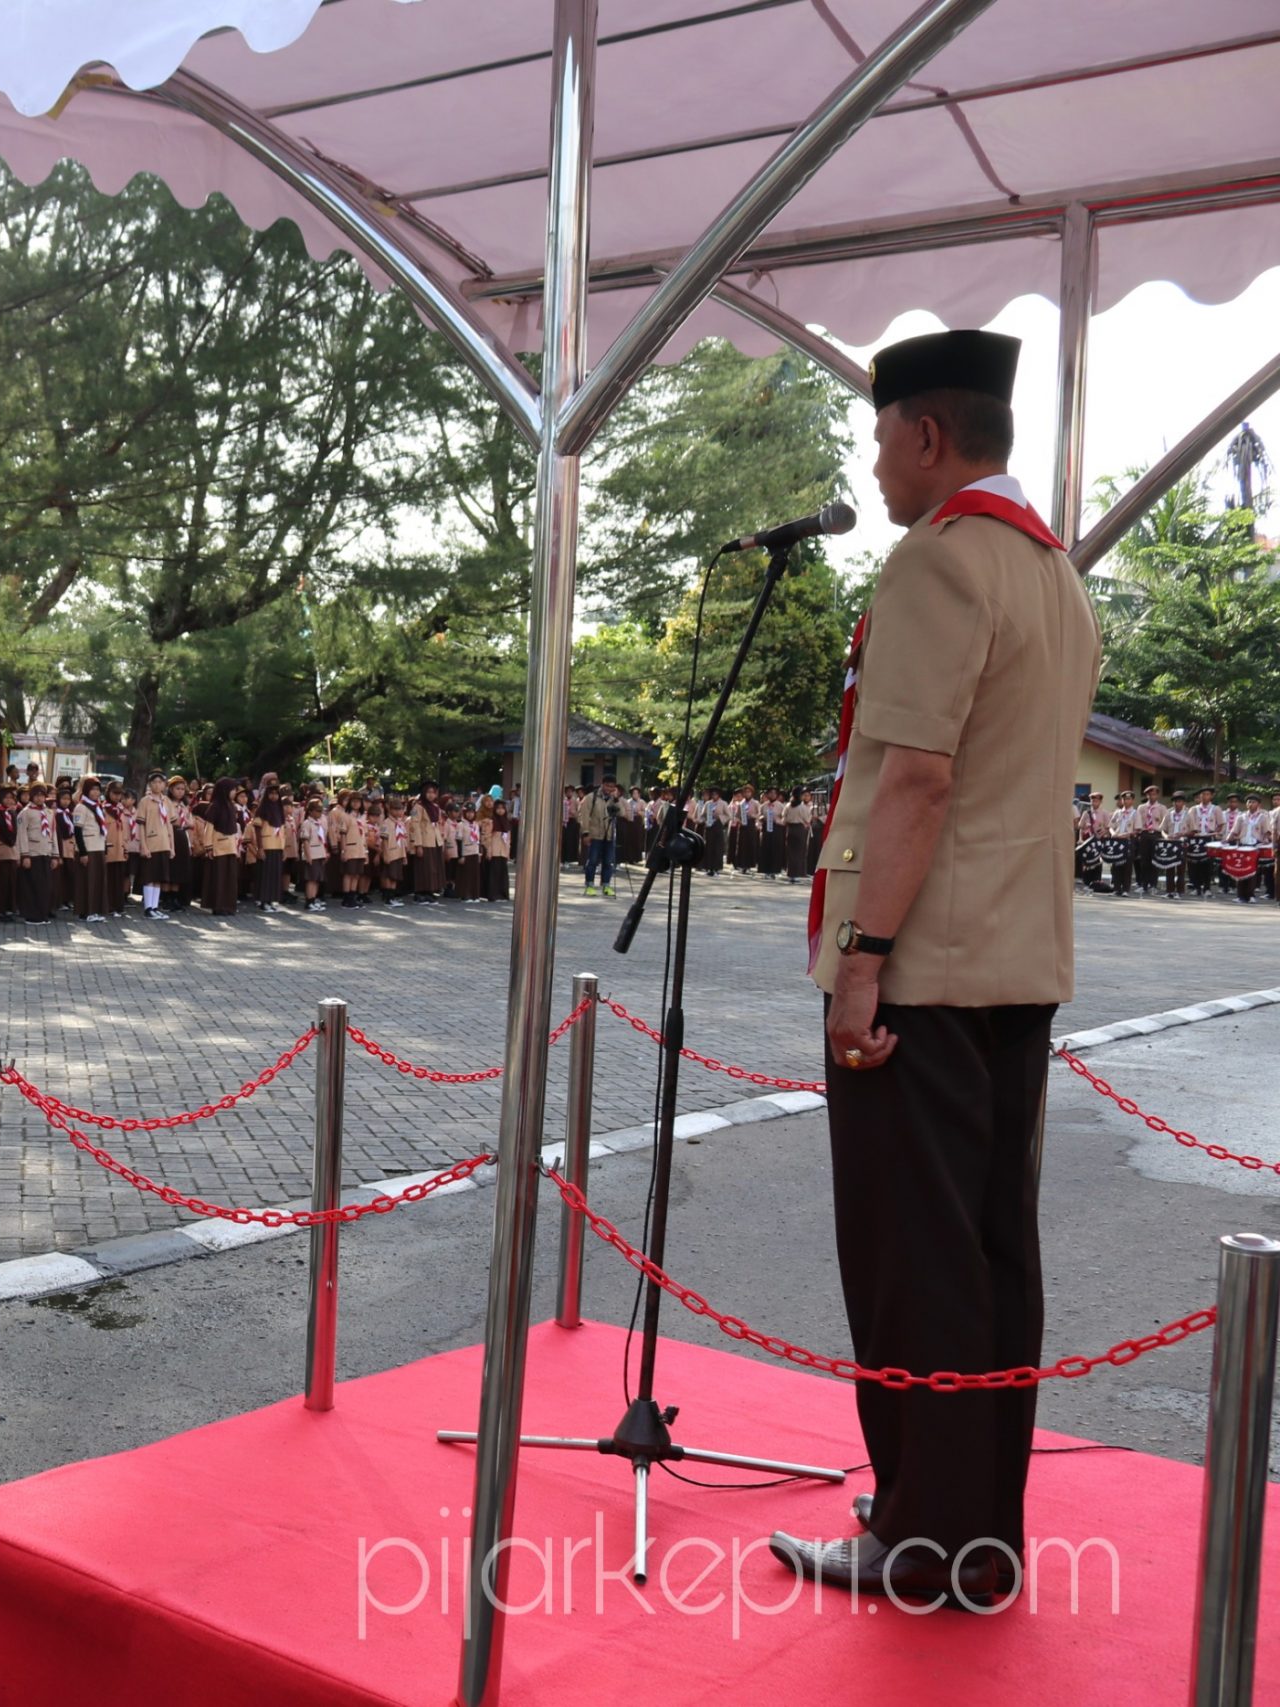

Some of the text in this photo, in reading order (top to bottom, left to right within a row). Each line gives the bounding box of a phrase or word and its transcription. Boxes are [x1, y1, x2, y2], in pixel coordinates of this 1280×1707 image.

[1091, 848, 1099, 857] 2
[1107, 846, 1114, 855] 2
[1160, 848, 1168, 857] 2
[1235, 858, 1242, 867] 2
